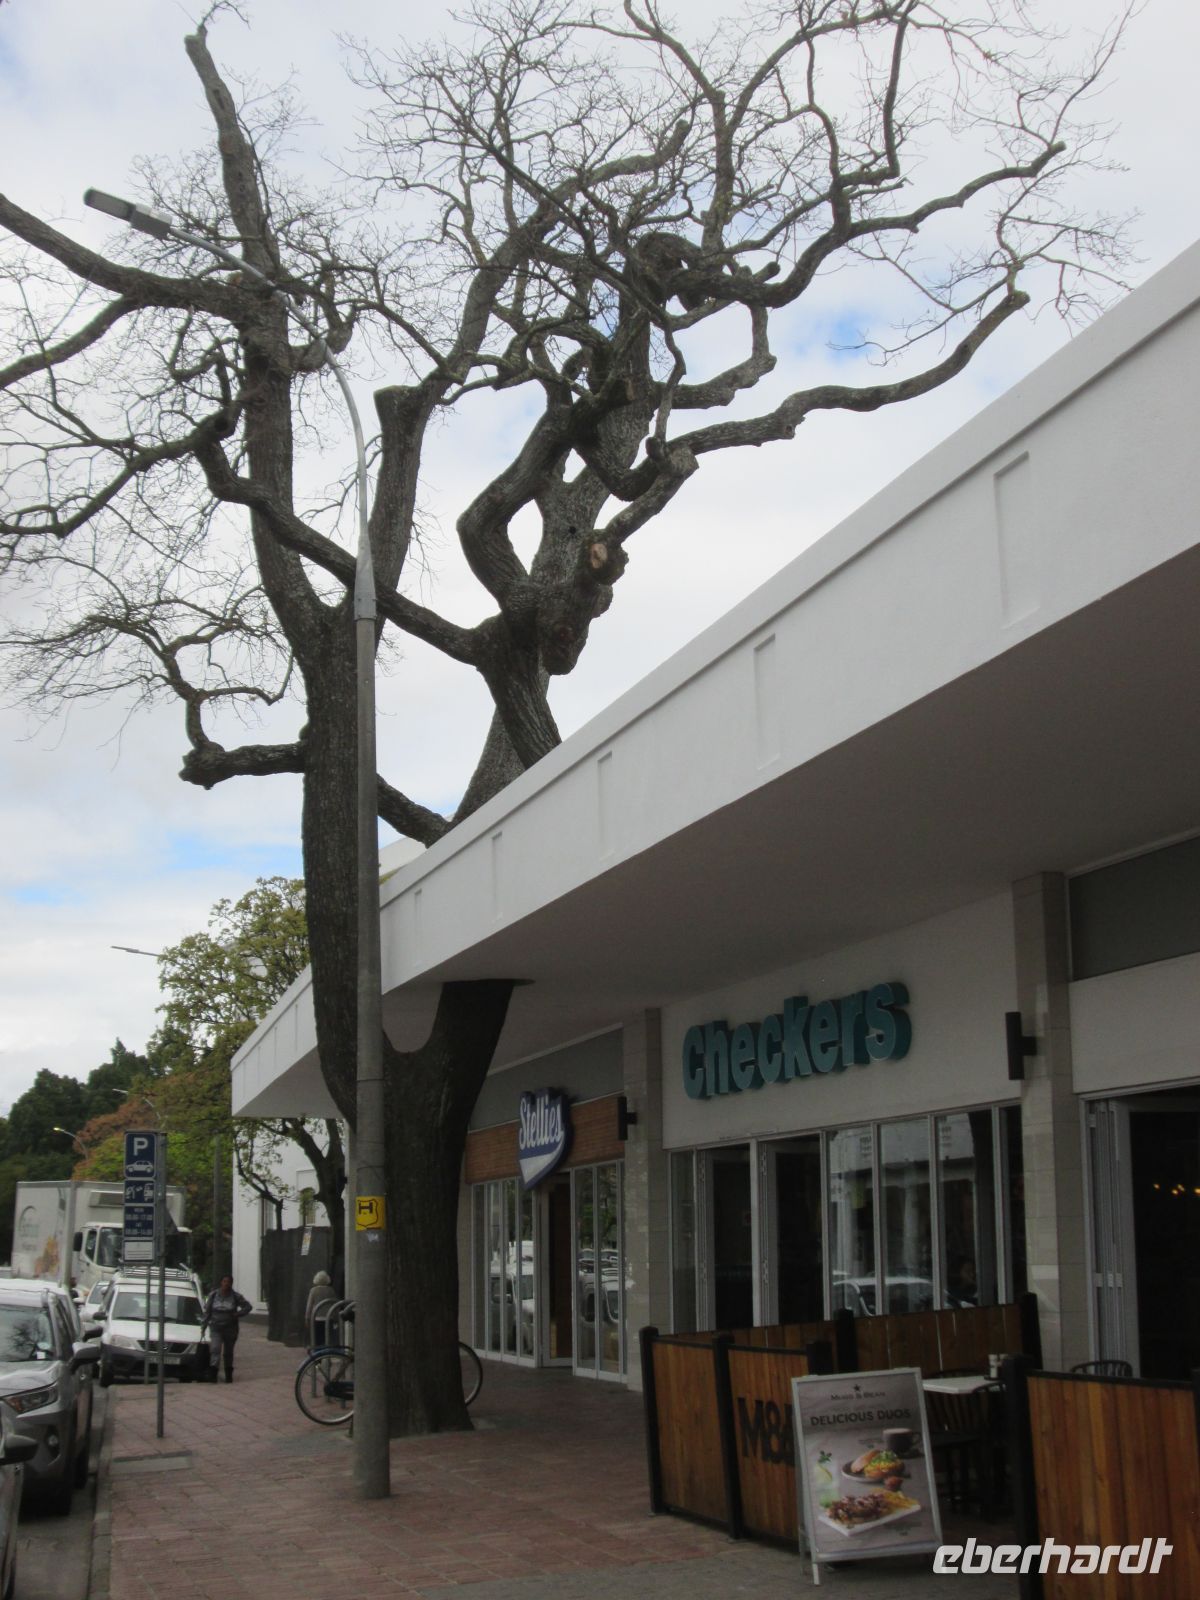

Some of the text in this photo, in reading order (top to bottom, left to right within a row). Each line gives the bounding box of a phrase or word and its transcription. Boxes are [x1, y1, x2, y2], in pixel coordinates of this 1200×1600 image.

[682, 982, 911, 1099] Checkers
[519, 1094, 564, 1150] Stellies
[133, 1137, 149, 1156] P
[810, 1408, 911, 1426] DELICIOUS DUOS
